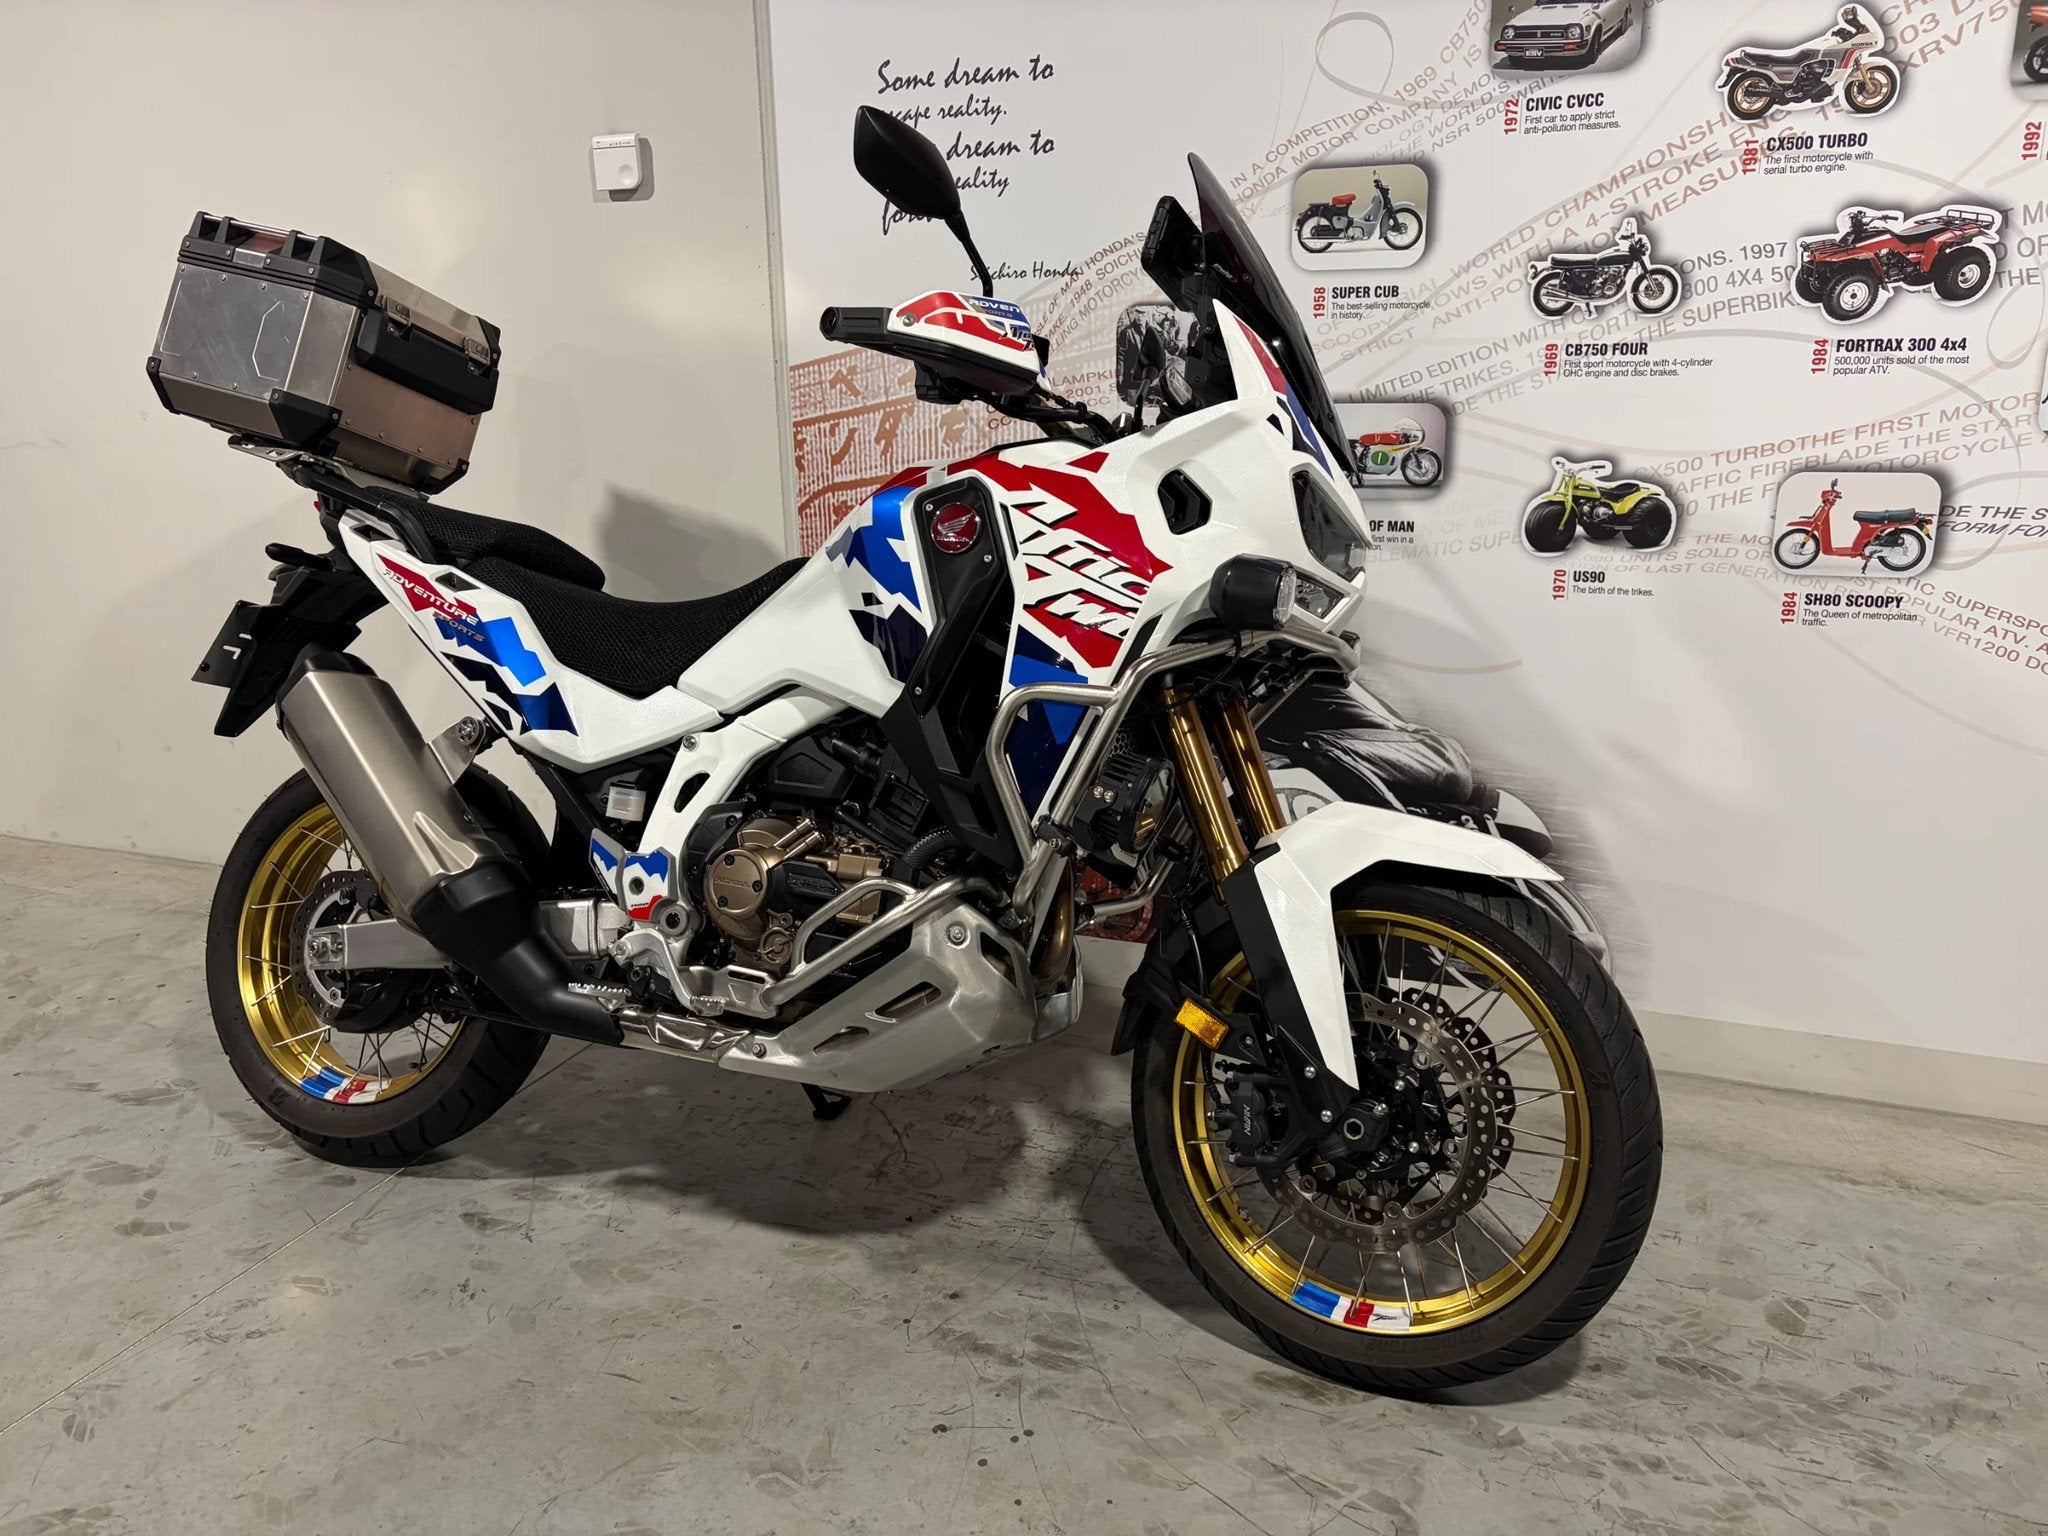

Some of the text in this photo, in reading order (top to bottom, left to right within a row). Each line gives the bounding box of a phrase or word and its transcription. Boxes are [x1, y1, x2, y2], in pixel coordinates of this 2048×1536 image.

[878, 54, 1054, 94] Some dream to
[937, 94, 1007, 125] reality.
[1291, 130, 1357, 167] MOTOR
[1364, 71, 1458, 135] COMPANY
[1462, 45, 1482, 68] IS
[1429, 81, 1510, 137] WORLD'S
[1526, 93, 1604, 112] CIVIC CVCC
[1504, 99, 1519, 134] 1972
[1525, 110, 1616, 124] First car to apply strict
[1230, 172, 1248, 189] IN
[1252, 162, 1264, 176] A
[1265, 100, 1390, 164] COMPETITION.
[1394, 66, 1437, 102] 1969
[1432, 123, 1470, 151] NSR
[1524, 121, 1621, 135] anti-pollution measures.
[946, 129, 1055, 161] dream to
[1766, 132, 1868, 151] CX500 TURBO
[2021, 122, 2042, 160] 1992
[1742, 139, 1759, 175] 1981
[1766, 151, 1873, 165] The first motorcycle with
[1764, 164, 1847, 175] serial turbo engine.
[955, 166, 1009, 197] eality
[1492, 238, 1554, 280] WITH
[1562, 227, 1580, 243] A
[1586, 141, 1722, 229] 4-STROKE
[1450, 226, 1536, 280] WORLD
[1033, 261, 1079, 279] Honda
[1069, 281, 1092, 308] 1948
[1313, 287, 1326, 318] 1958
[1332, 286, 1399, 299] SUPER CUB
[1332, 300, 1430, 311] The best-selling motorcycle
[1340, 311, 1365, 320] history.
[1426, 338, 1509, 385] EDITION
[1739, 241, 1788, 261] 1997
[1440, 360, 1519, 395] TRIKES.
[1726, 269, 1764, 288] 4X4
[1565, 342, 1648, 356] CB750 FOUR
[1836, 338, 1967, 353] FORTRAX 300 4x4
[1544, 343, 1559, 377] 1969
[1564, 358, 1713, 368] First sport motorcycle with 4-cylinder
[1811, 339, 1829, 374] 1984
[1834, 355, 1969, 366] 500,000 units sold of the most
[1563, 368, 1680, 378] OHC engine and disc brakes.
[1833, 366, 1890, 376] popular ATV.
[1065, 384, 1101, 399] 2001
[1854, 412, 1930, 440] FIRST
[1750, 414, 2033, 480] FIREBLADE THE STAR
[1707, 484, 1756, 511] THE
[1979, 506, 2028, 521] THE
[1369, 520, 1415, 532] OF MAN
[1372, 535, 1384, 543] first
[1687, 534, 1734, 545] THE
[1684, 548, 1740, 559] SOLD
[1573, 571, 1605, 583] US90
[1645, 563, 1695, 573] LAST
[1552, 569, 1567, 600] 1970
[1573, 586, 1586, 594] The
[1588, 586, 1606, 594] birth
[1617, 587, 1629, 595] the
[1632, 588, 1654, 596] trikes.
[382, 569, 479, 626] ADVENTURE
[1781, 592, 1798, 624] 1984
[1804, 593, 1903, 608] SH80 SCOOPY
[1802, 618, 1828, 626] traffic.
[1803, 609, 1819, 618] The
[1821, 610, 1850, 619] Queen
[1852, 611, 1861, 619] of
[1862, 612, 1917, 622] metropolitan
[431, 611, 485, 642] SPORTS
[1983, 625, 2029, 648] ATV.
[1933, 624, 2021, 662] VFR1200
